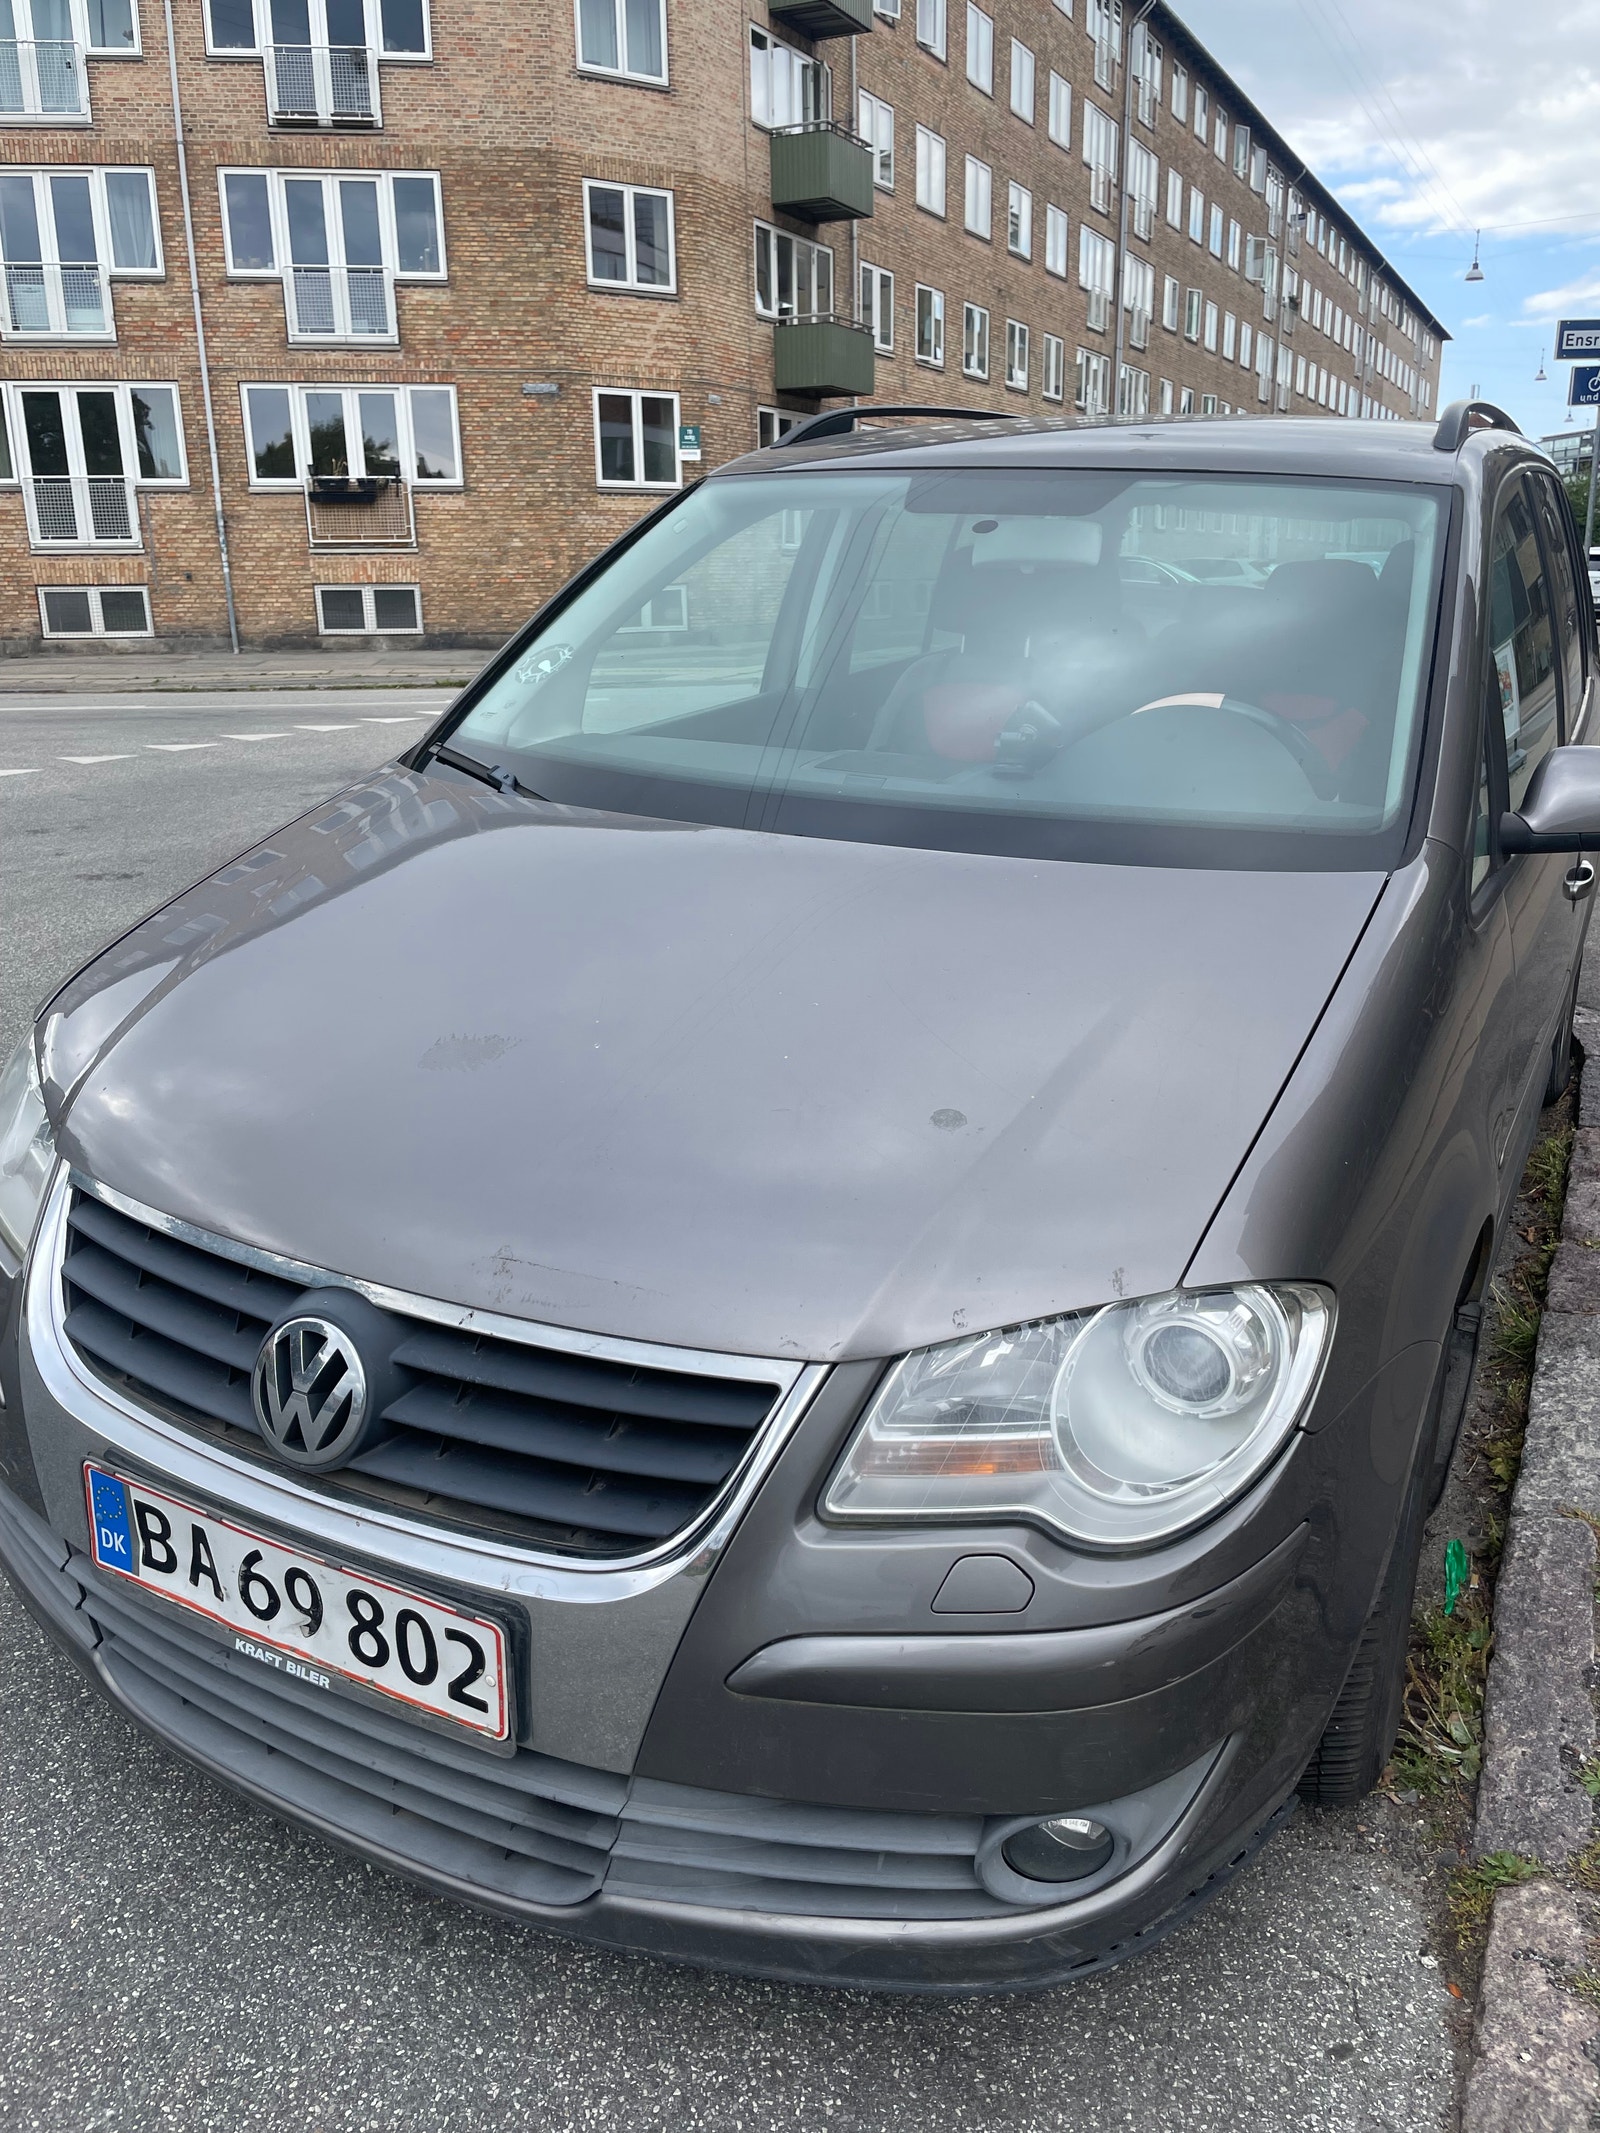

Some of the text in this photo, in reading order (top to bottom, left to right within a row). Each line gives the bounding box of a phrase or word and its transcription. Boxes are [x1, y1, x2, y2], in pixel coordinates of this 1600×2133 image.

[1566, 333, 1600, 347] Ensr
[101, 1526, 127, 1555] DK
[134, 1498, 489, 1714] BA 69 802
[235, 1638, 330, 1689] KRAFT BILER
